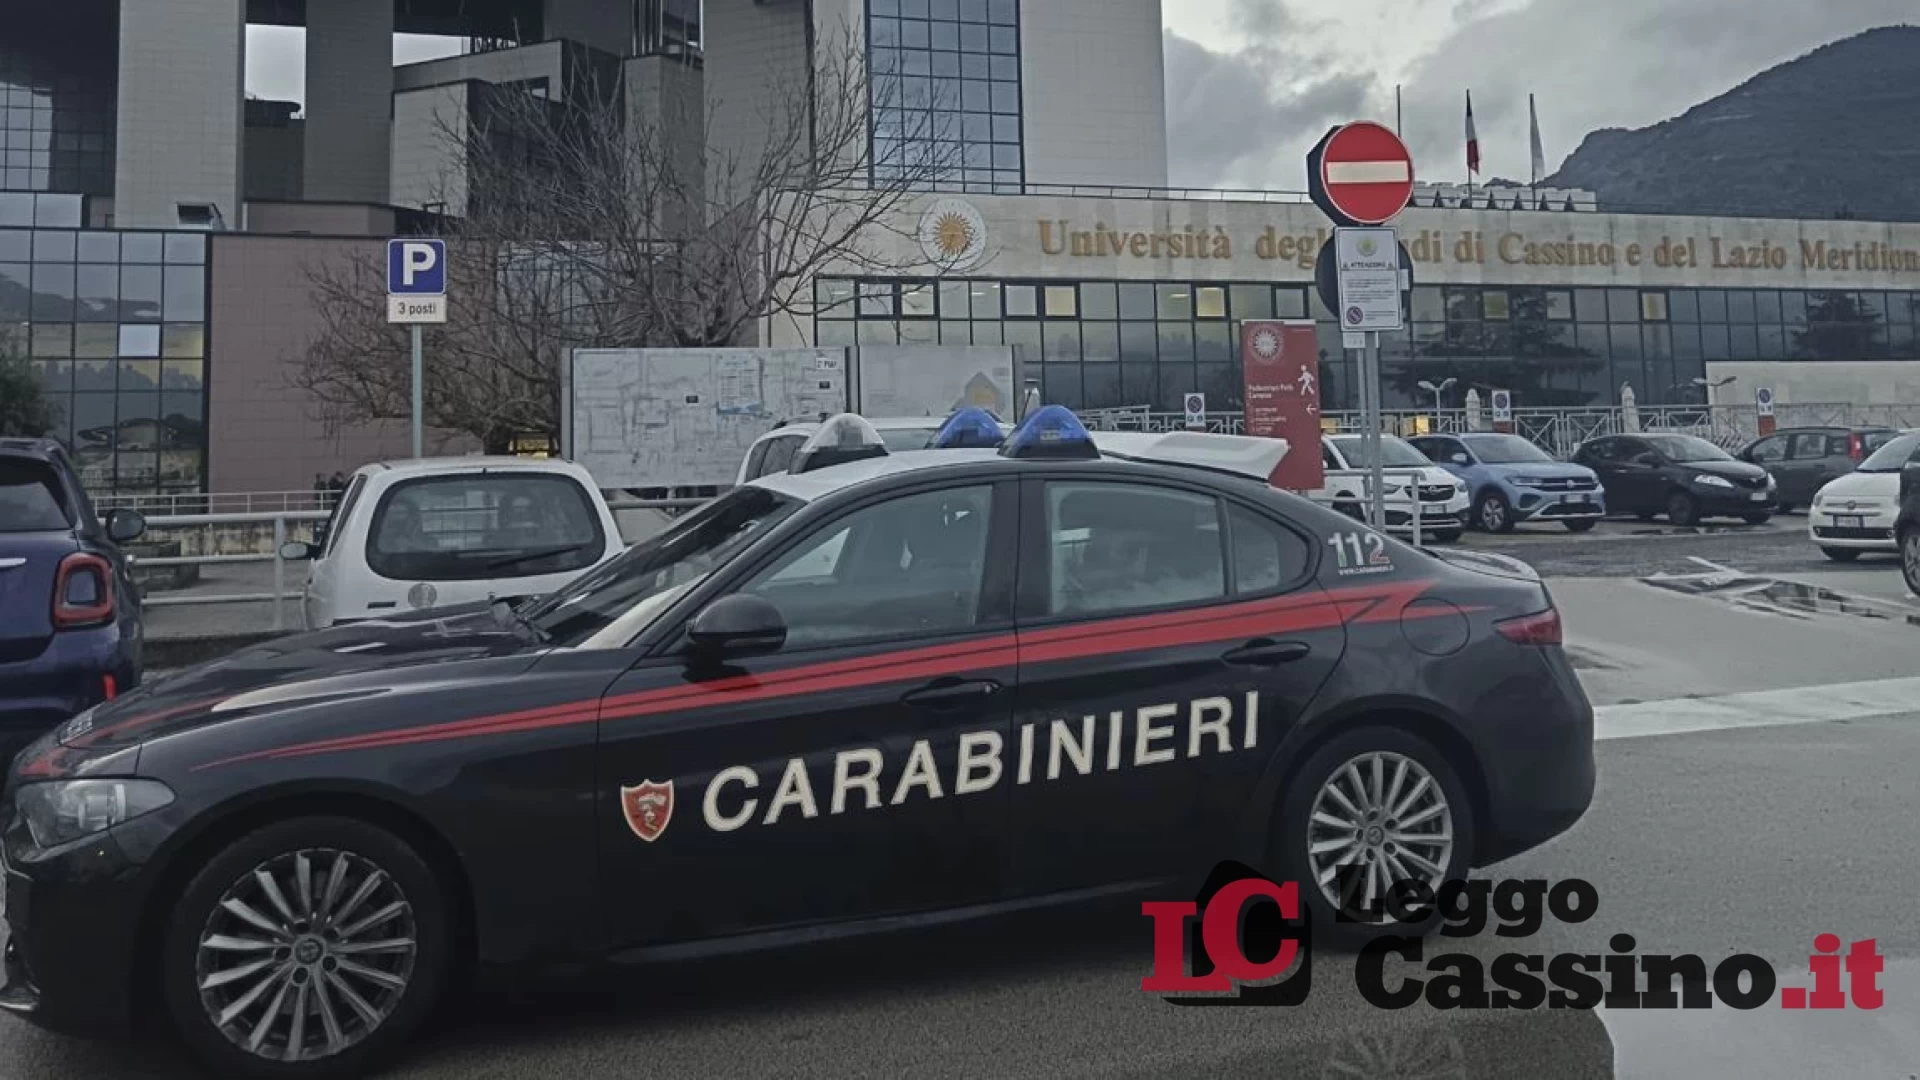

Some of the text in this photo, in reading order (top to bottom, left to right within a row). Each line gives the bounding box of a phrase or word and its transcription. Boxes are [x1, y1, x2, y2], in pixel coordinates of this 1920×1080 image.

[402, 243, 436, 286] P
[1037, 219, 1233, 260] Università
[1455, 231, 1486, 265] di
[1498, 232, 1616, 267] Cassino
[1626, 242, 1642, 267] e
[1653, 235, 1698, 268] del
[1710, 236, 1787, 270] Lazio
[398, 302, 436, 316] 3 posti
[1327, 532, 1391, 568] 112
[702, 690, 1260, 833] CARABINIERI
